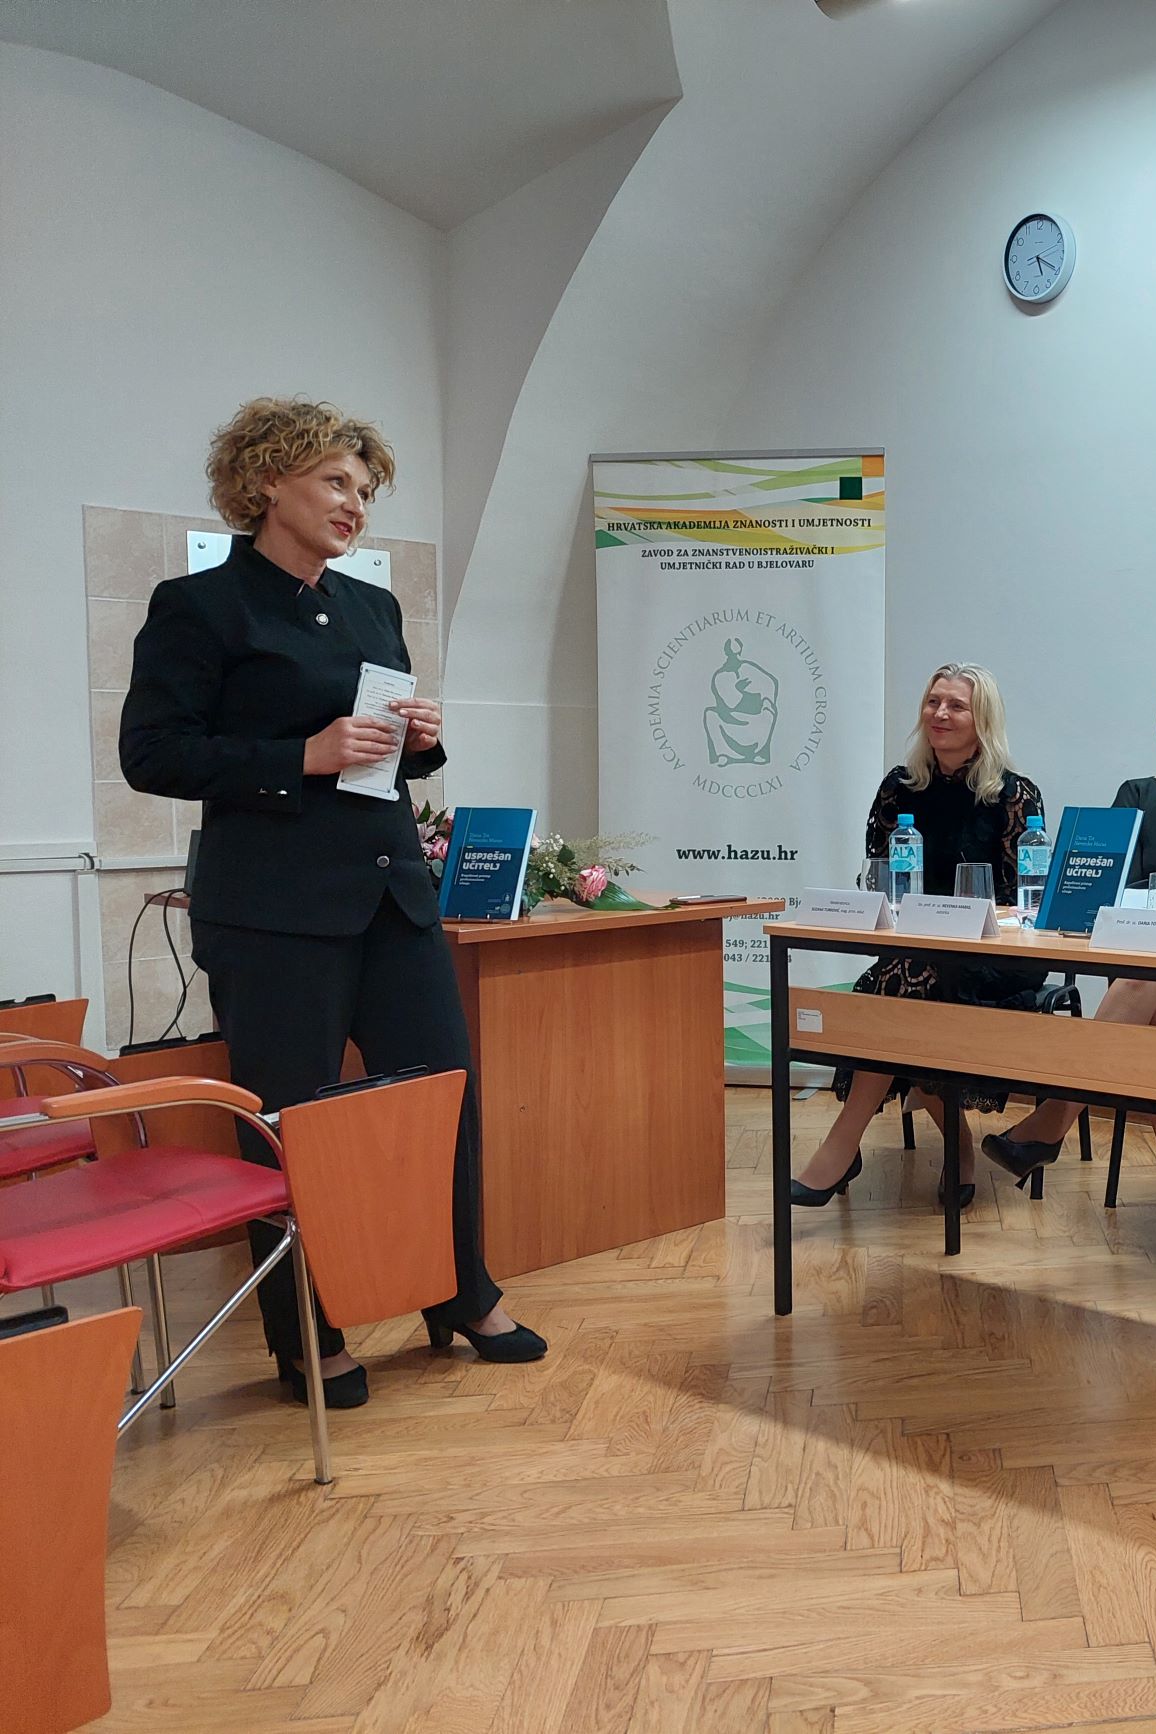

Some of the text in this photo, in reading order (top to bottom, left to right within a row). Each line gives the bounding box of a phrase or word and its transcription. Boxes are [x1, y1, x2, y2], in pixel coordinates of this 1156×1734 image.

[607, 518, 872, 531] HRVATSKA AKADEMIJA ZNANOSTI I UMJETNOSTI
[641, 545, 835, 558] ZAVOD ZA ZNANSTVENOISTRAŽIVAČKI I
[660, 560, 814, 570] UMJETNIČKI RAD U BJELOVARU
[654, 608, 824, 682] SCIENTIARUM ET ARTIUM
[647, 683, 828, 773] ACADEMIA CROATICA
[692, 774, 784, 800] MDCCCLXI
[676, 844, 798, 861] www.hazu.hr
[725, 939, 768, 949] 549; 221
[723, 953, 742, 962] 043
[752, 954, 770, 963] 221
